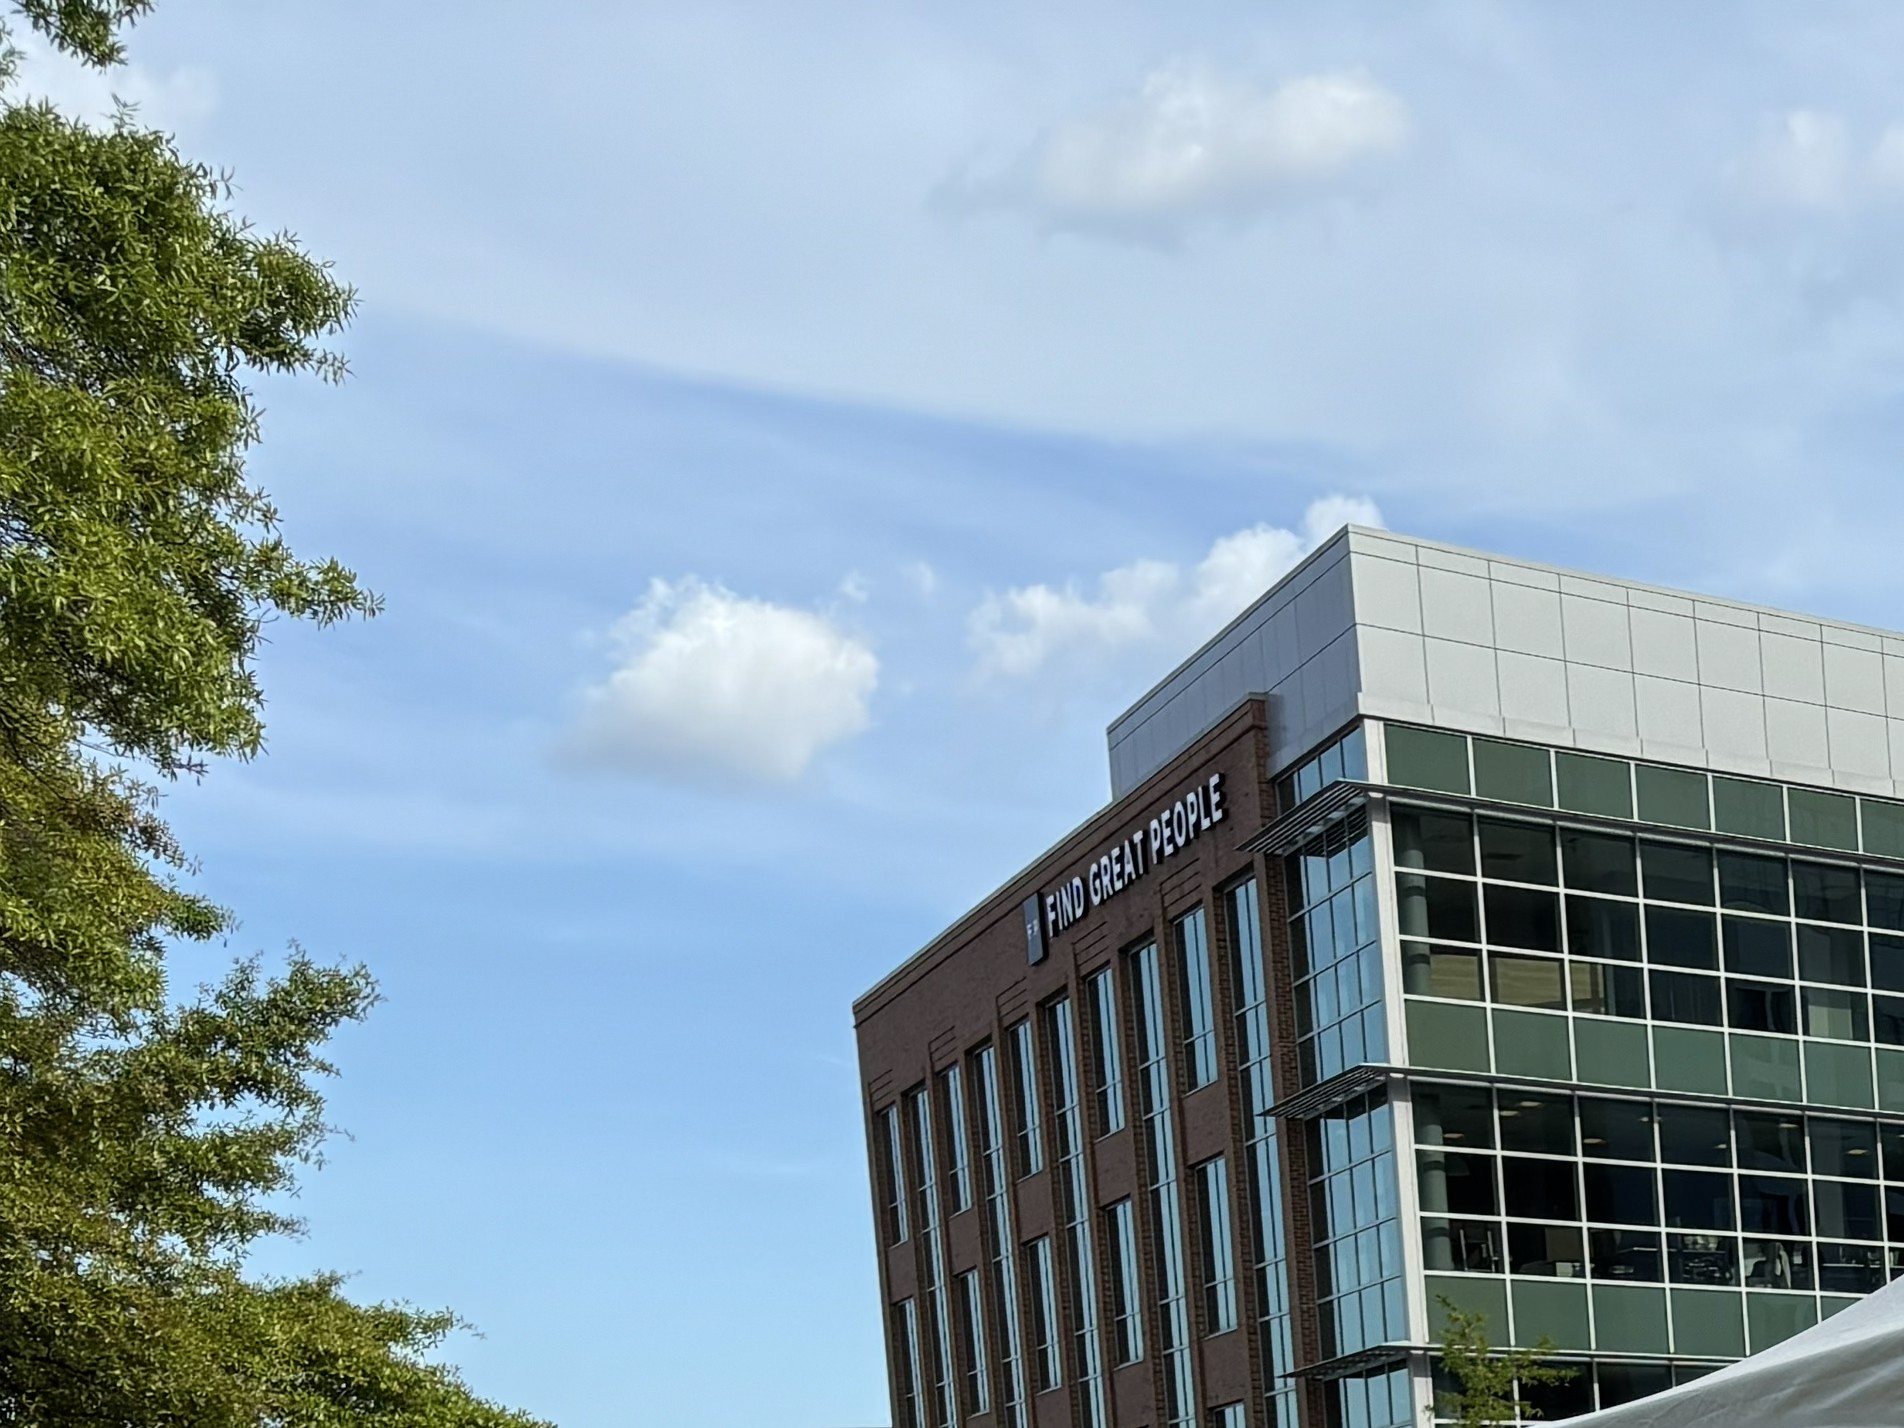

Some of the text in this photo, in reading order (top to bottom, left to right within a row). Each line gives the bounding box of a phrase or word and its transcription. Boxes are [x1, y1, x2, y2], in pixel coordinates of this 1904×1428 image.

[1046, 876, 1085, 938] FIND
[1089, 830, 1144, 906] GREAT
[1149, 773, 1224, 864] PEOPLE
